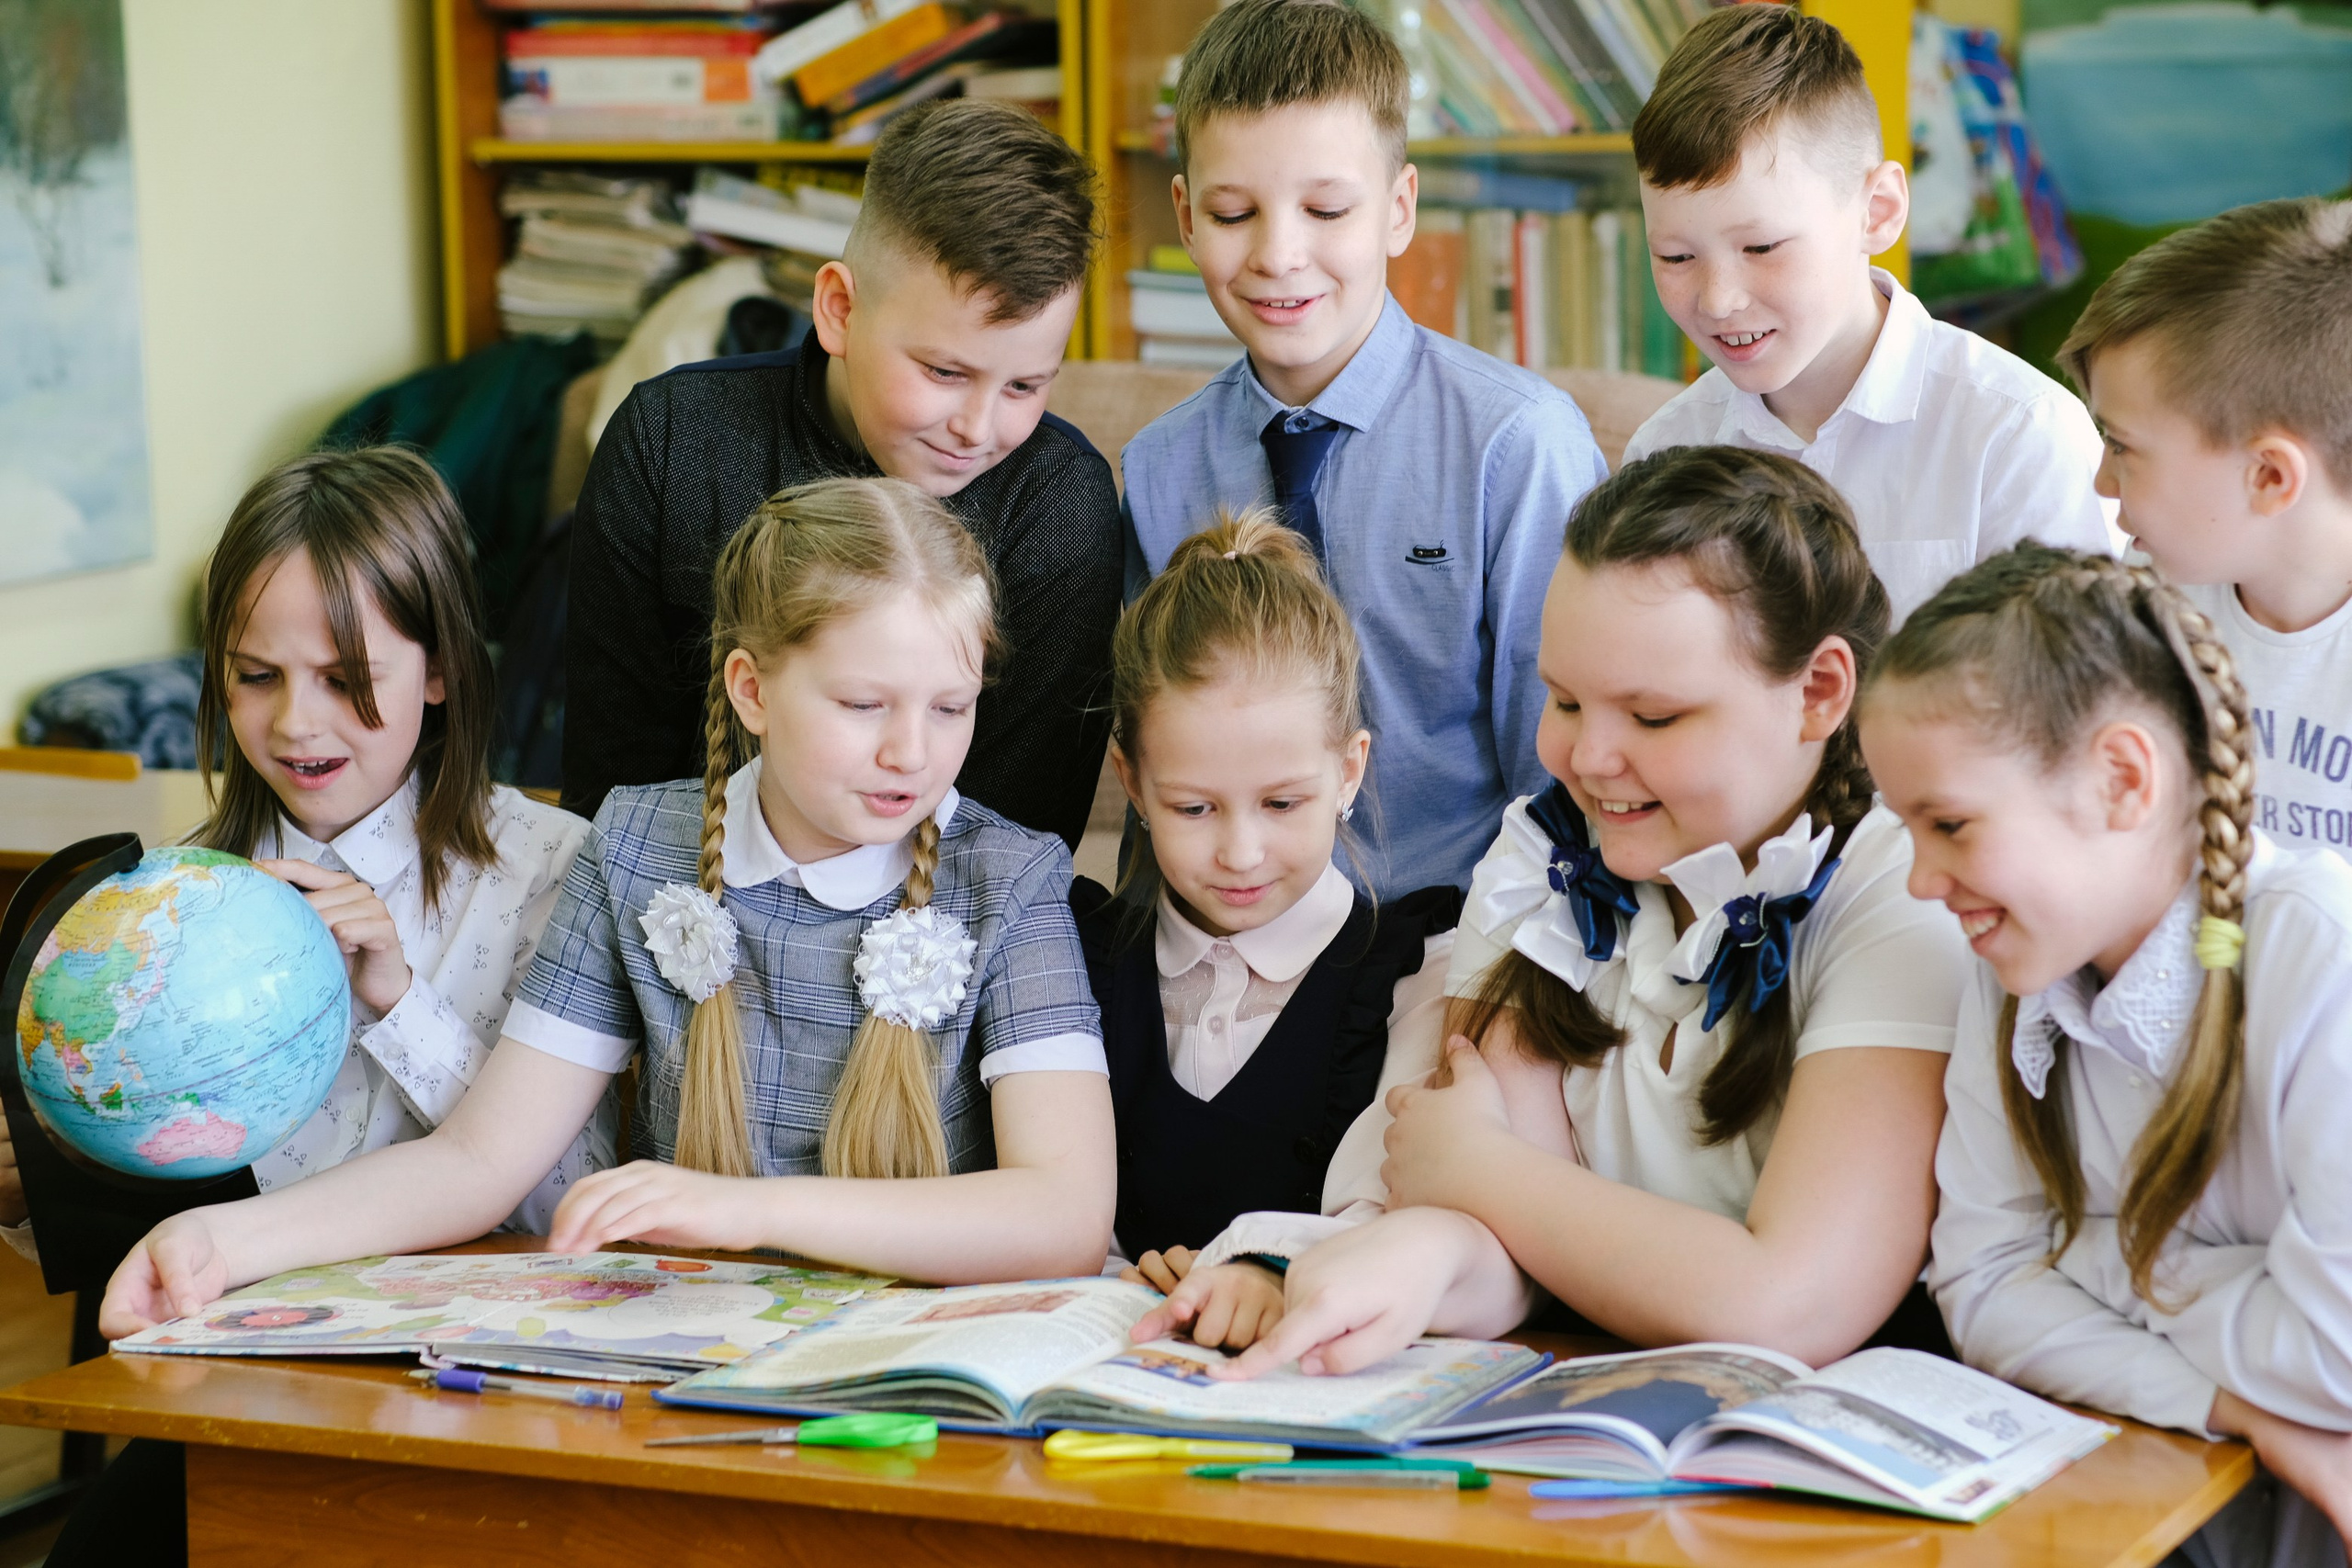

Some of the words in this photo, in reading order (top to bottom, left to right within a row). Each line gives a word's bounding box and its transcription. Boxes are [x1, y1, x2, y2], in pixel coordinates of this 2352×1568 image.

[2289, 716, 2352, 790] MO
[2253, 794, 2278, 832] R
[2288, 801, 2352, 848] STO
